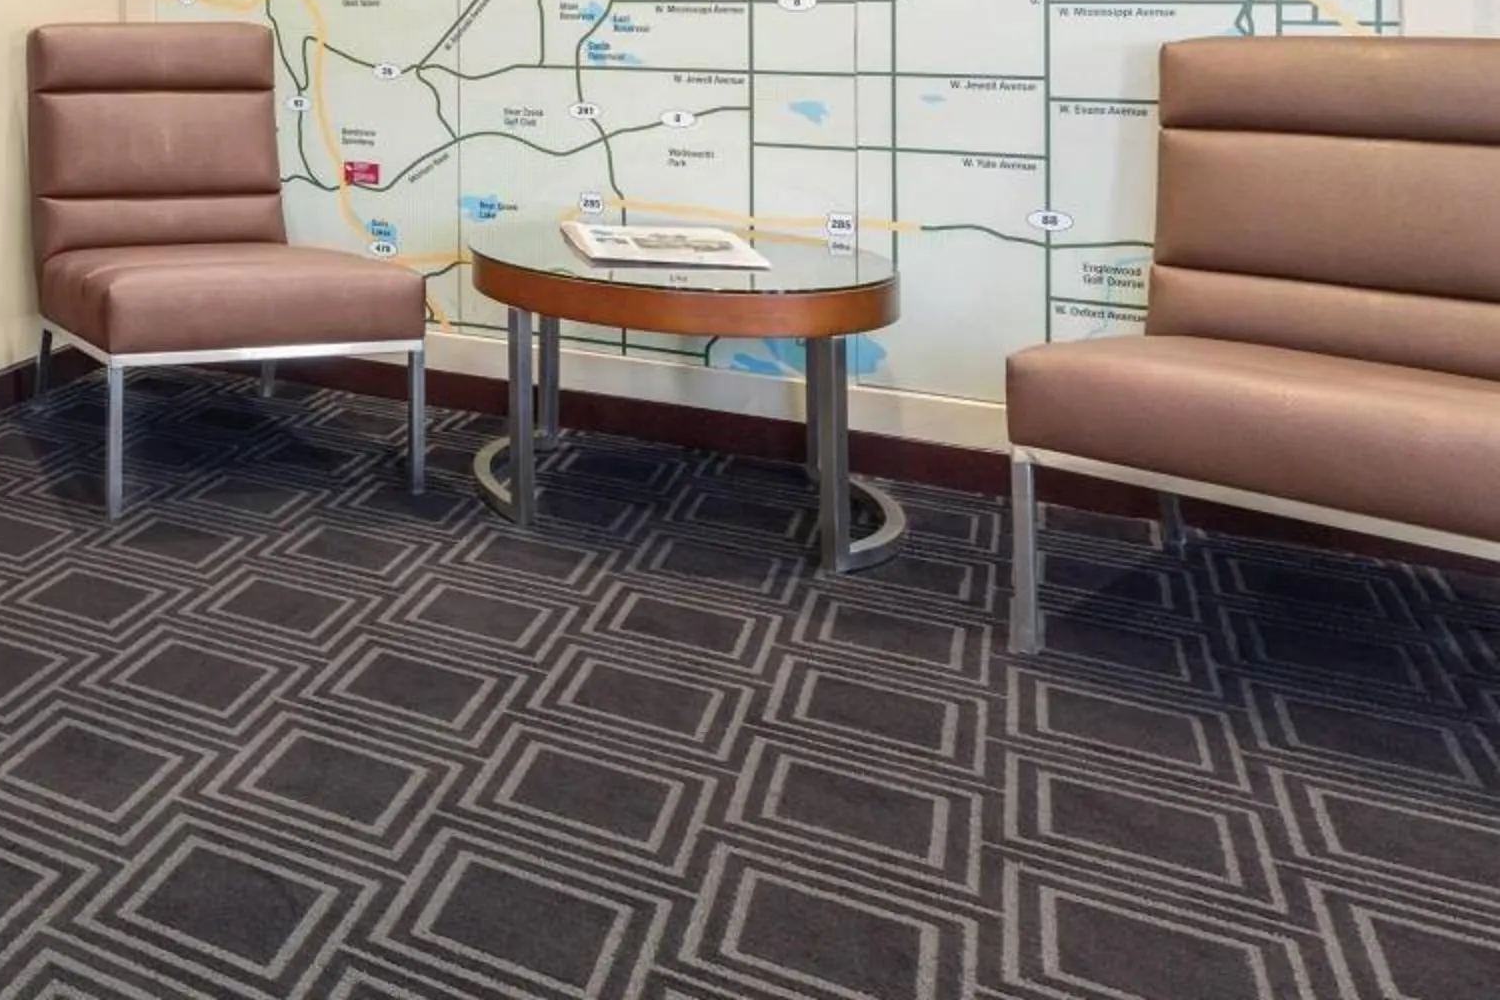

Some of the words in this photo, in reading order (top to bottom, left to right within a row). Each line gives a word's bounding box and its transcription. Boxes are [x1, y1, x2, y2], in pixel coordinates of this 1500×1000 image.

[1073, 8, 1133, 18] Mississippi
[1135, 8, 1176, 18] Avenue
[999, 81, 1036, 92] Avenue
[1074, 105, 1105, 115] Evans
[1107, 106, 1148, 117] Avenue
[999, 161, 1037, 171] Avenue
[1082, 263, 1143, 277] Englewood
[1082, 274, 1104, 286] Golf
[1106, 276, 1145, 289] Course
